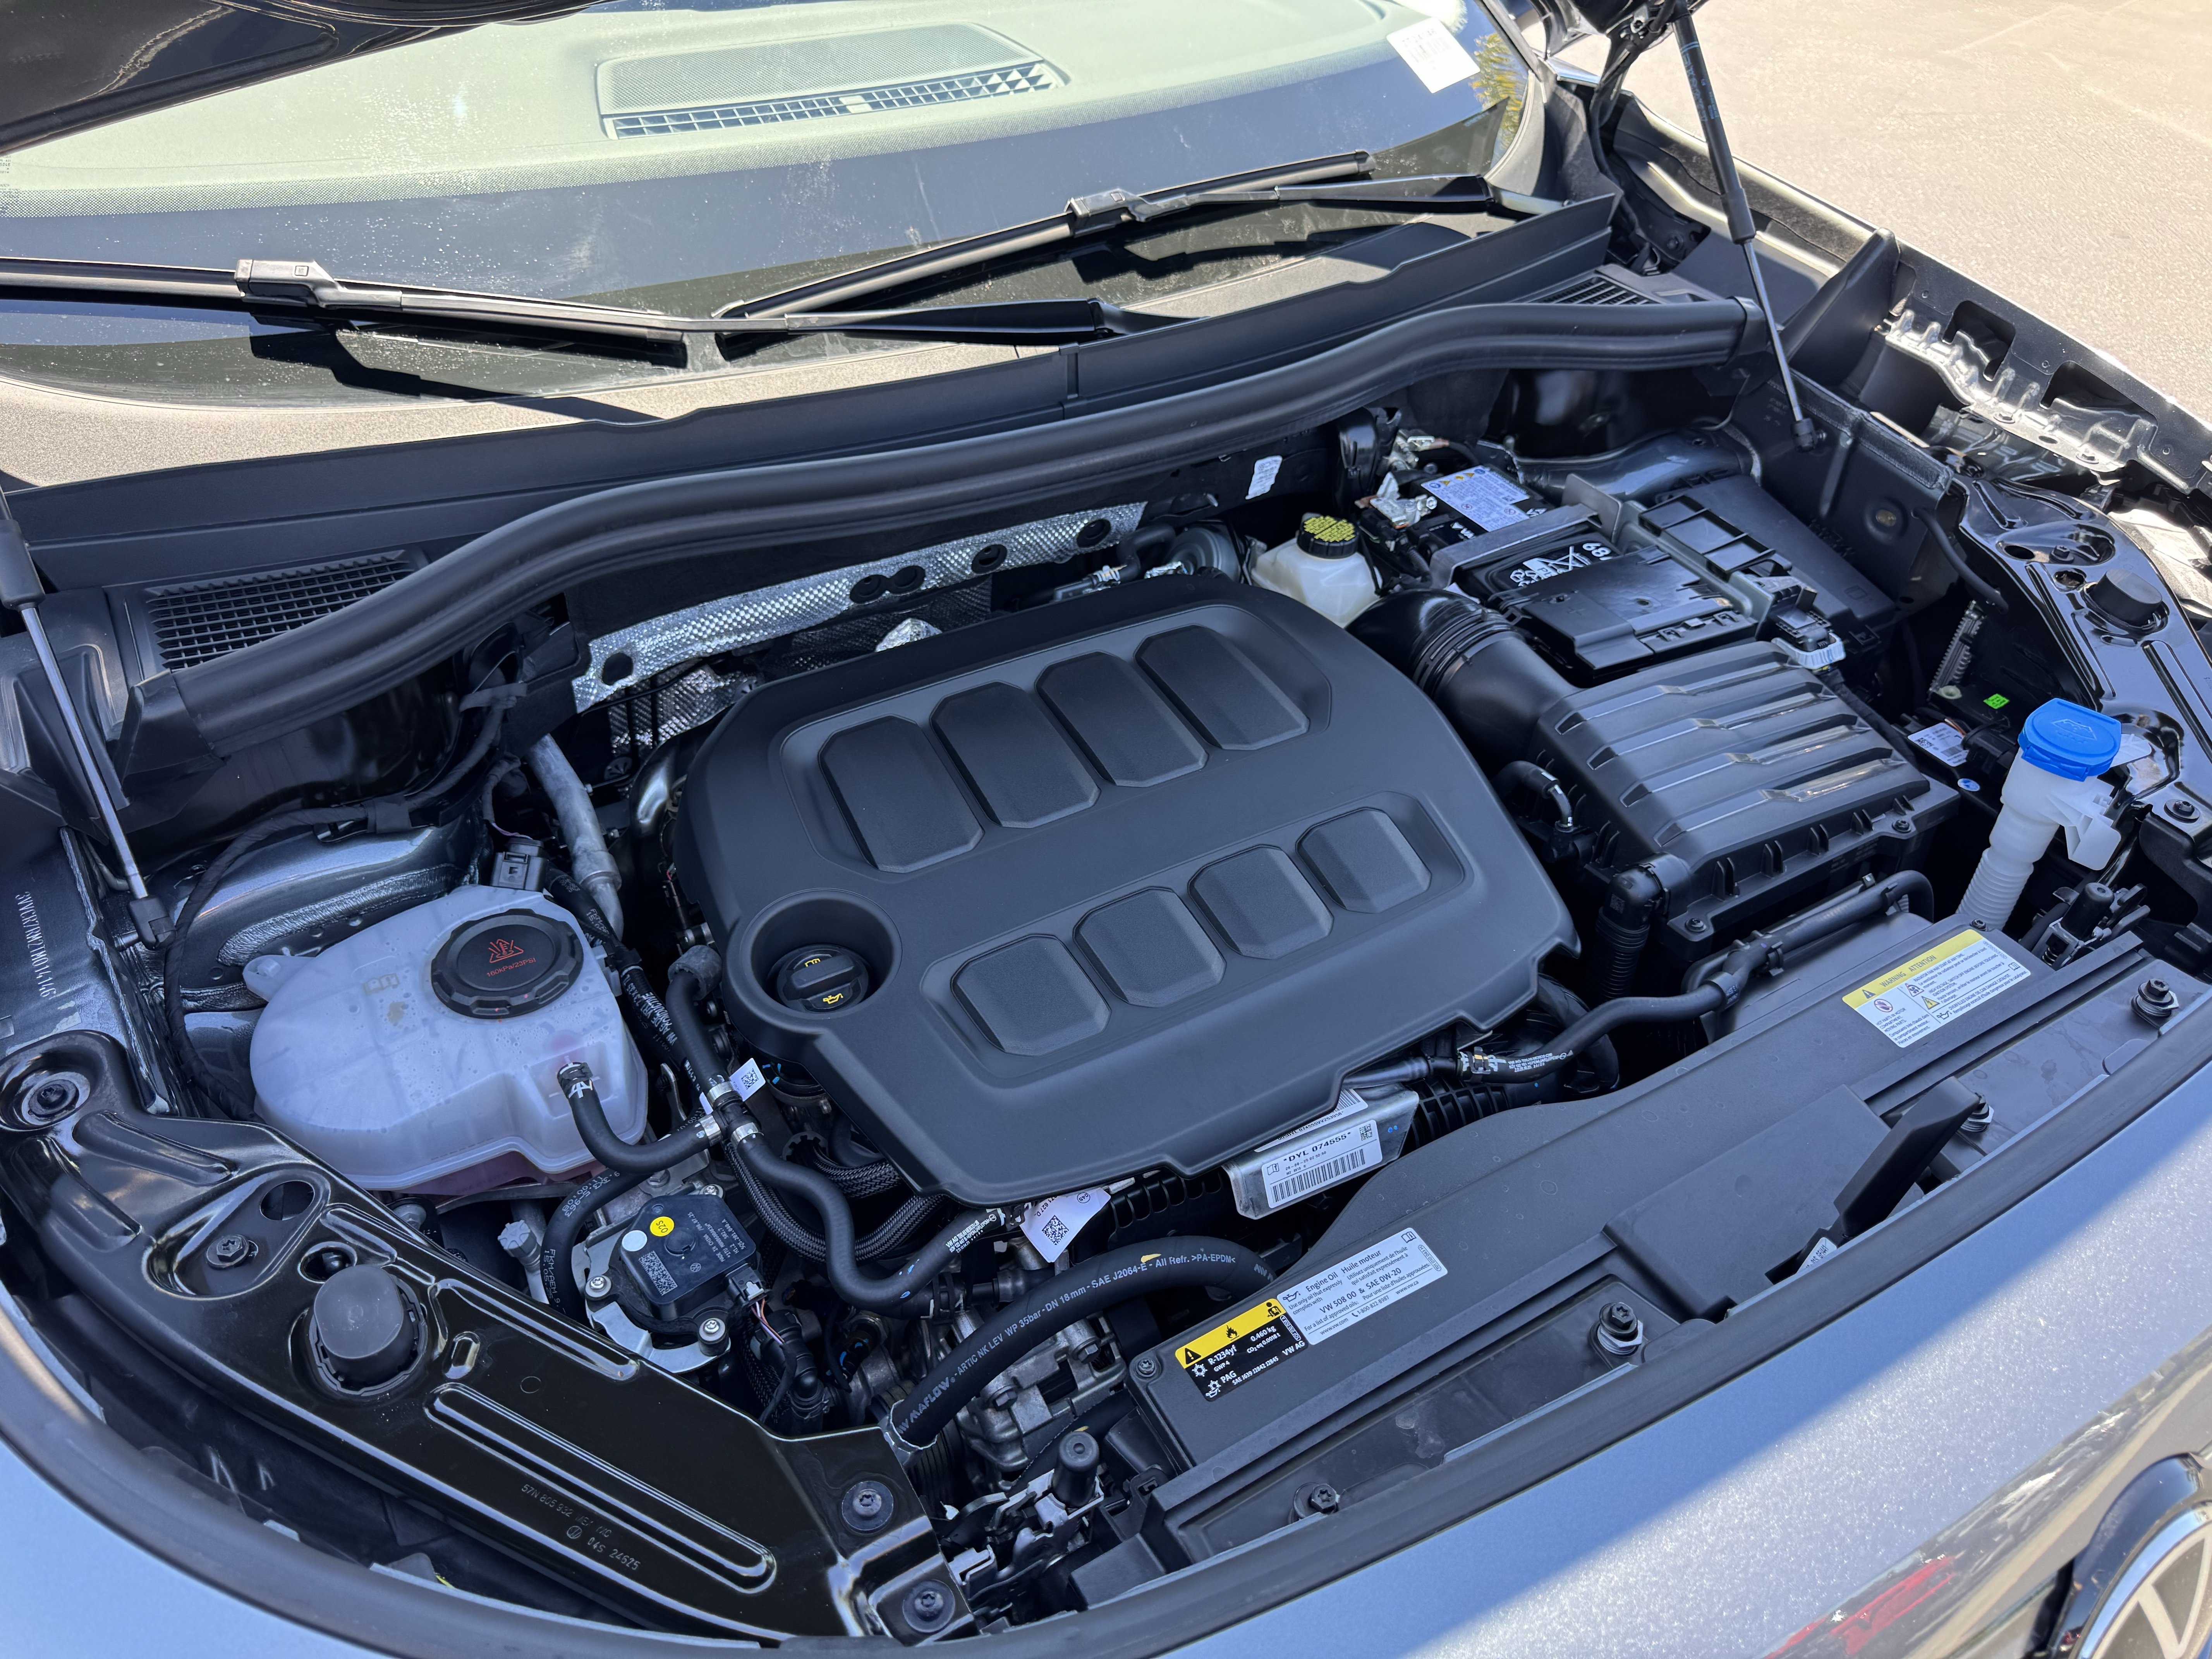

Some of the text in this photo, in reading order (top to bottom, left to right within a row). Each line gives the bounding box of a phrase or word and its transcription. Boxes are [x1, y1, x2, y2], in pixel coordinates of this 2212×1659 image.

[1879, 954, 1937, 988] WARNING ATTENTION
[702, 1233, 714, 1247] CHINA
[715, 1251, 726, 1263] MADE
[1340, 1249, 1382, 1274] Huile moteur
[1346, 1268, 1364, 1280] Utilisez
[1362, 1255, 1390, 1273] uniquement
[1393, 1245, 1408, 1255] l'huile
[1350, 1278, 1360, 1286] qui
[1357, 1269, 1376, 1281] satisfait
[1374, 1254, 1406, 1273] expressément
[1362, 1291, 1374, 1300] Pour
[1380, 1282, 1391, 1291] liste
[1389, 1274, 1407, 1286] d'huiles
[1404, 1261, 1431, 1278] approuvées:
[1296, 1297, 1309, 1306] only
[1312, 1288, 1323, 1297] that
[1321, 1278, 1343, 1293] expressly
[1305, 1271, 1338, 1293] Engine Oil
[1319, 1302, 1334, 1314] VW
[1332, 1295, 1347, 1307] 508
[1345, 1290, 1357, 1300] 00
[1365, 1278, 1380, 1290] SAE
[1378, 1267, 1402, 1283] 0W-20
[1395, 1280, 1419, 1295] www.vw.ca
[957, 1356, 978, 1375] ARTIC
[977, 1347, 990, 1359] NK
[988, 1333, 1003, 1348] LEV
[1006, 1322, 1018, 1337] WP
[1019, 1310, 1042, 1328] 35bar
[1045, 1299, 1059, 1312] DN
[1091, 1274, 1111, 1289] SAE
[1112, 1262, 1147, 1280] J2064-E
[1155, 1258, 1167, 1267] All
[1169, 1255, 1190, 1265] Refr.
[1191, 1253, 1236, 1264] >PA-EPDM<
[1291, 1296, 1323, 1316] complies with
[1327, 1304, 1350, 1319] approved
[1347, 1299, 1359, 1308] oils:
[1357, 1295, 1390, 1315] 1-800-822-8987
[1249, 1324, 1277, 1342] 0.460 kg
[1319, 1317, 1349, 1335] www.vw.com
[1261, 1333, 1278, 1345] 0.0018
[1281, 1340, 1306, 1357] VW AG
[1207, 1344, 1239, 1367] R-1234yf
[1213, 1362, 1226, 1372] GWP
[1219, 1370, 1237, 1384] PAG
[1231, 1355, 1279, 1385] SAE J639 J2842 J2845
[538, 1492, 558, 1510] 805
[555, 1501, 575, 1519] 932
